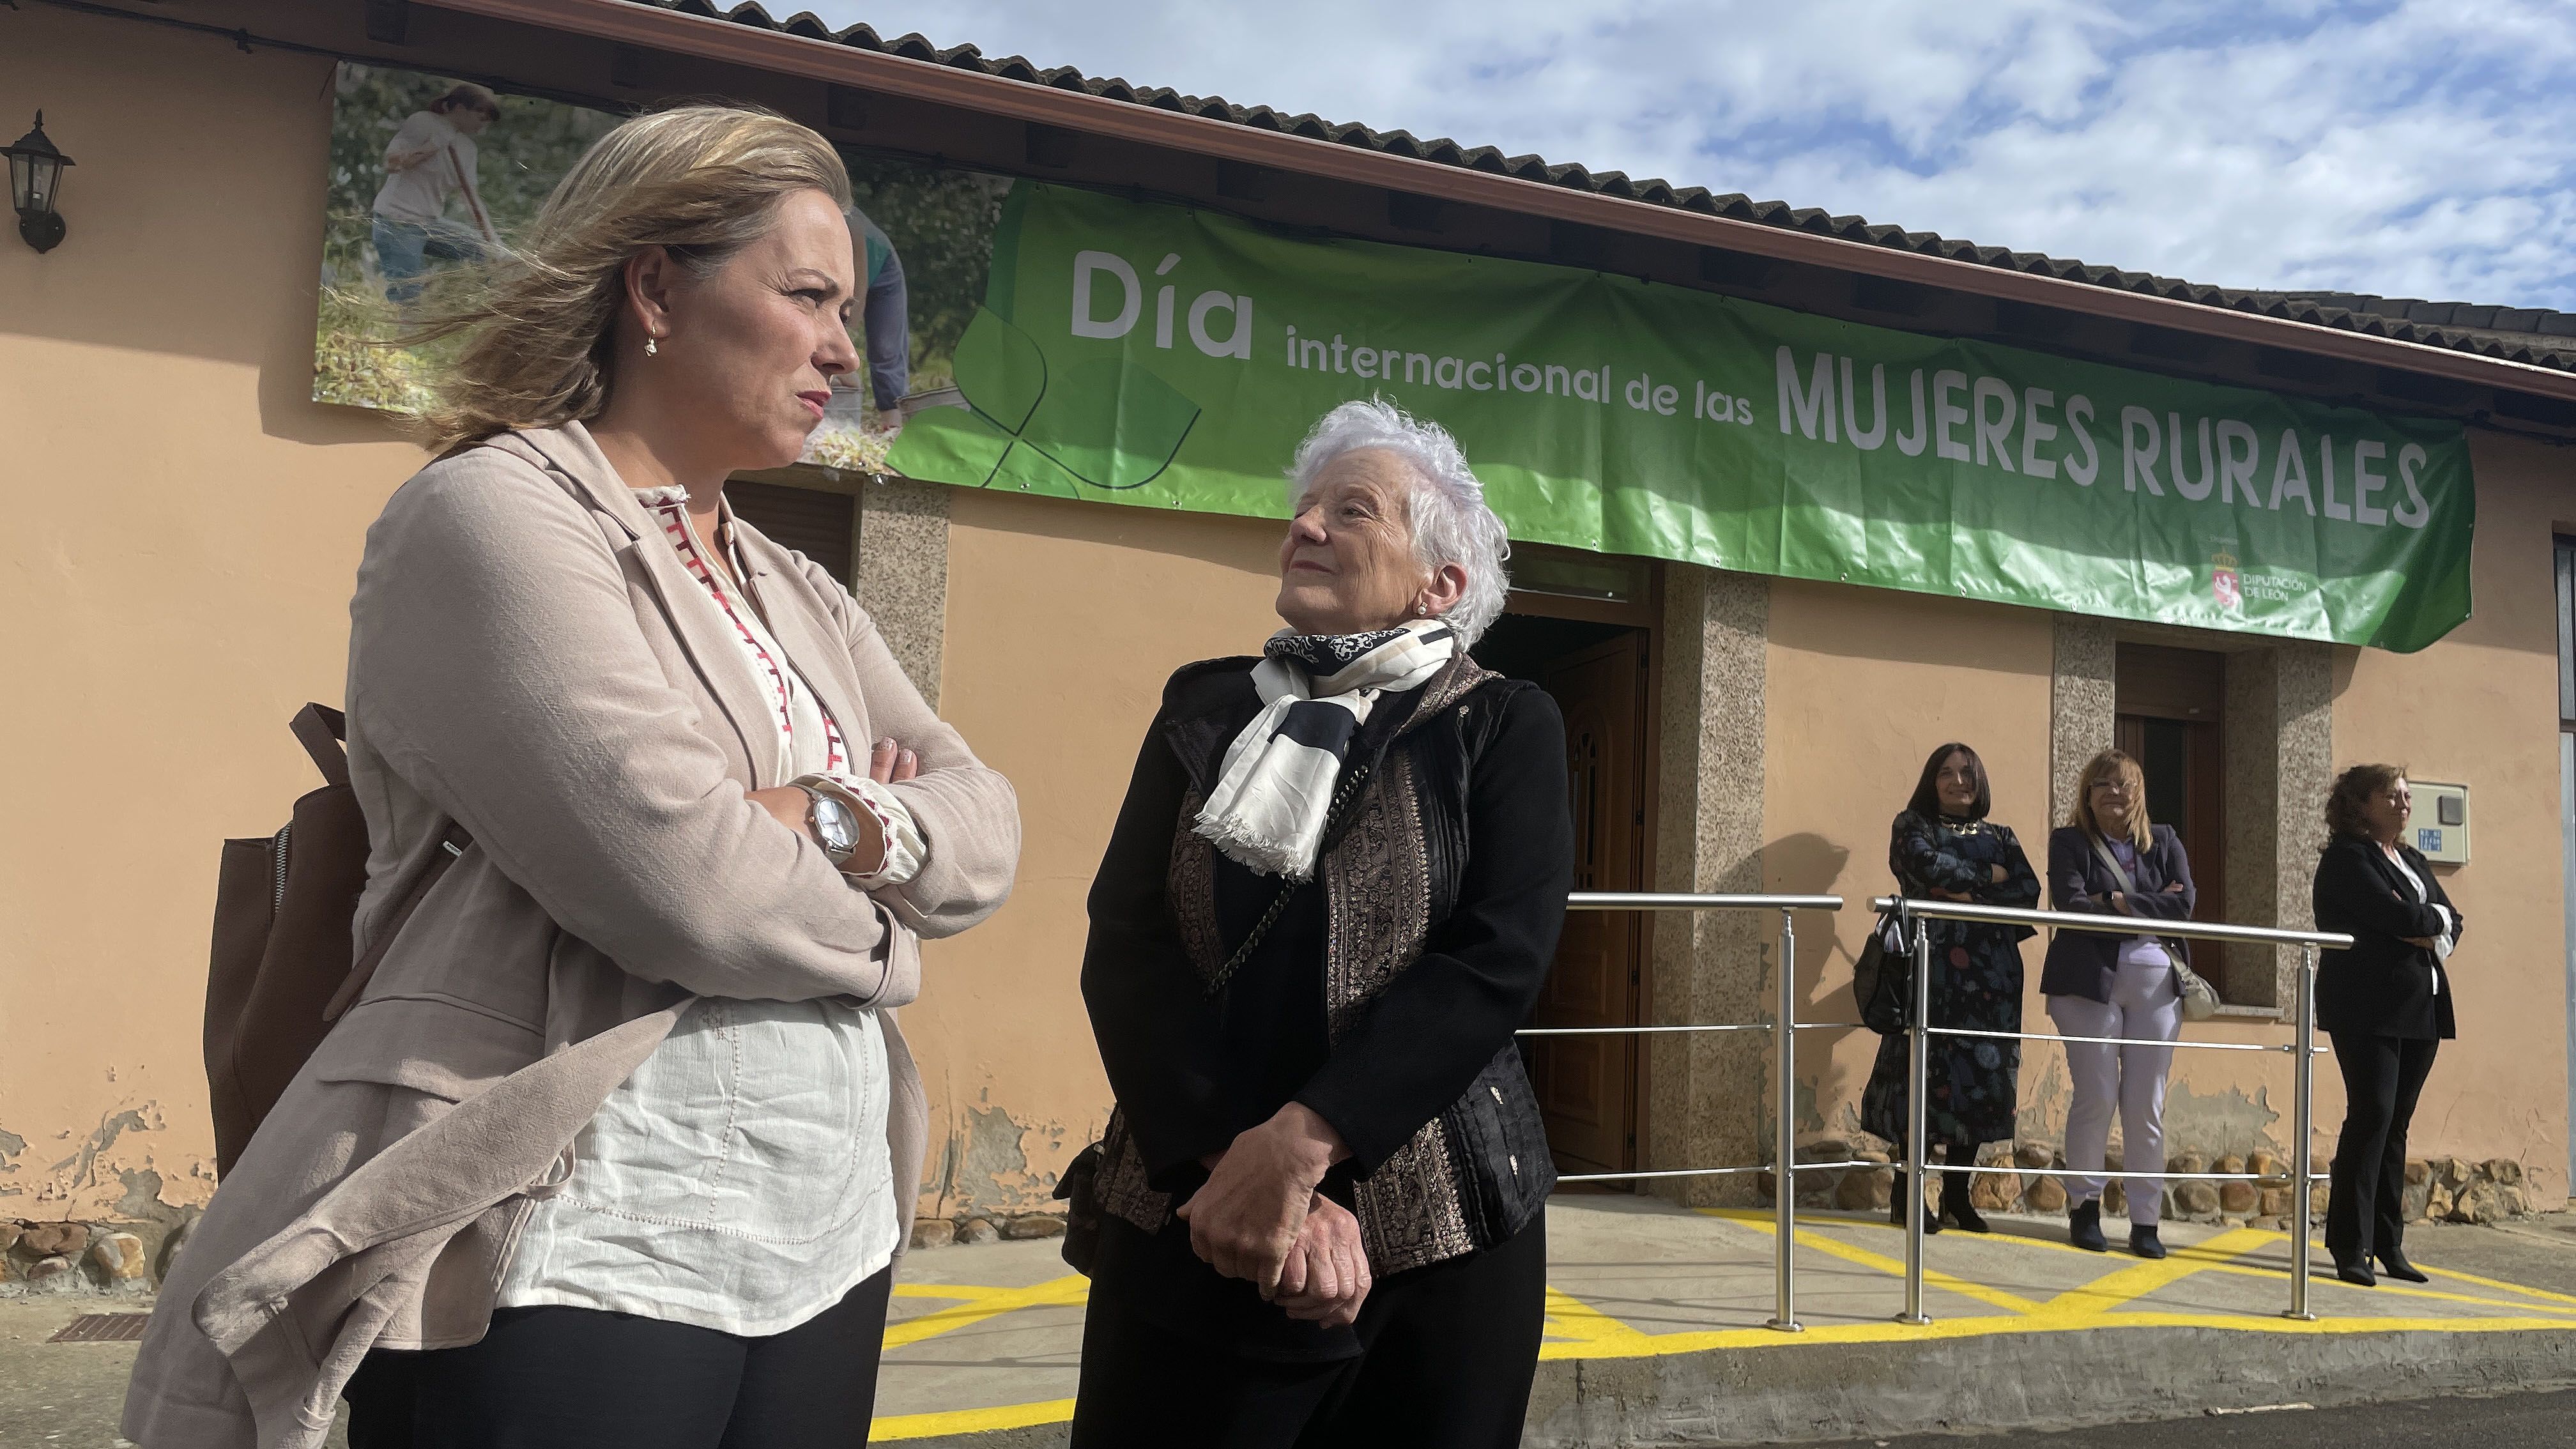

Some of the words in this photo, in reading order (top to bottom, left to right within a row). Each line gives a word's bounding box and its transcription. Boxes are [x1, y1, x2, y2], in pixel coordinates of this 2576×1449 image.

[1071, 250, 1253, 360] Día
[1286, 325, 1610, 404] internacional
[1625, 372, 1679, 417] de
[1694, 380, 1754, 425] las
[1775, 345, 2099, 486] MUJERES
[2120, 406, 2430, 529] RURALES
[2243, 573, 2307, 592] DIPUTACIÓN
[2244, 586, 2259, 598] DE
[2262, 586, 2289, 601] LEÓN
